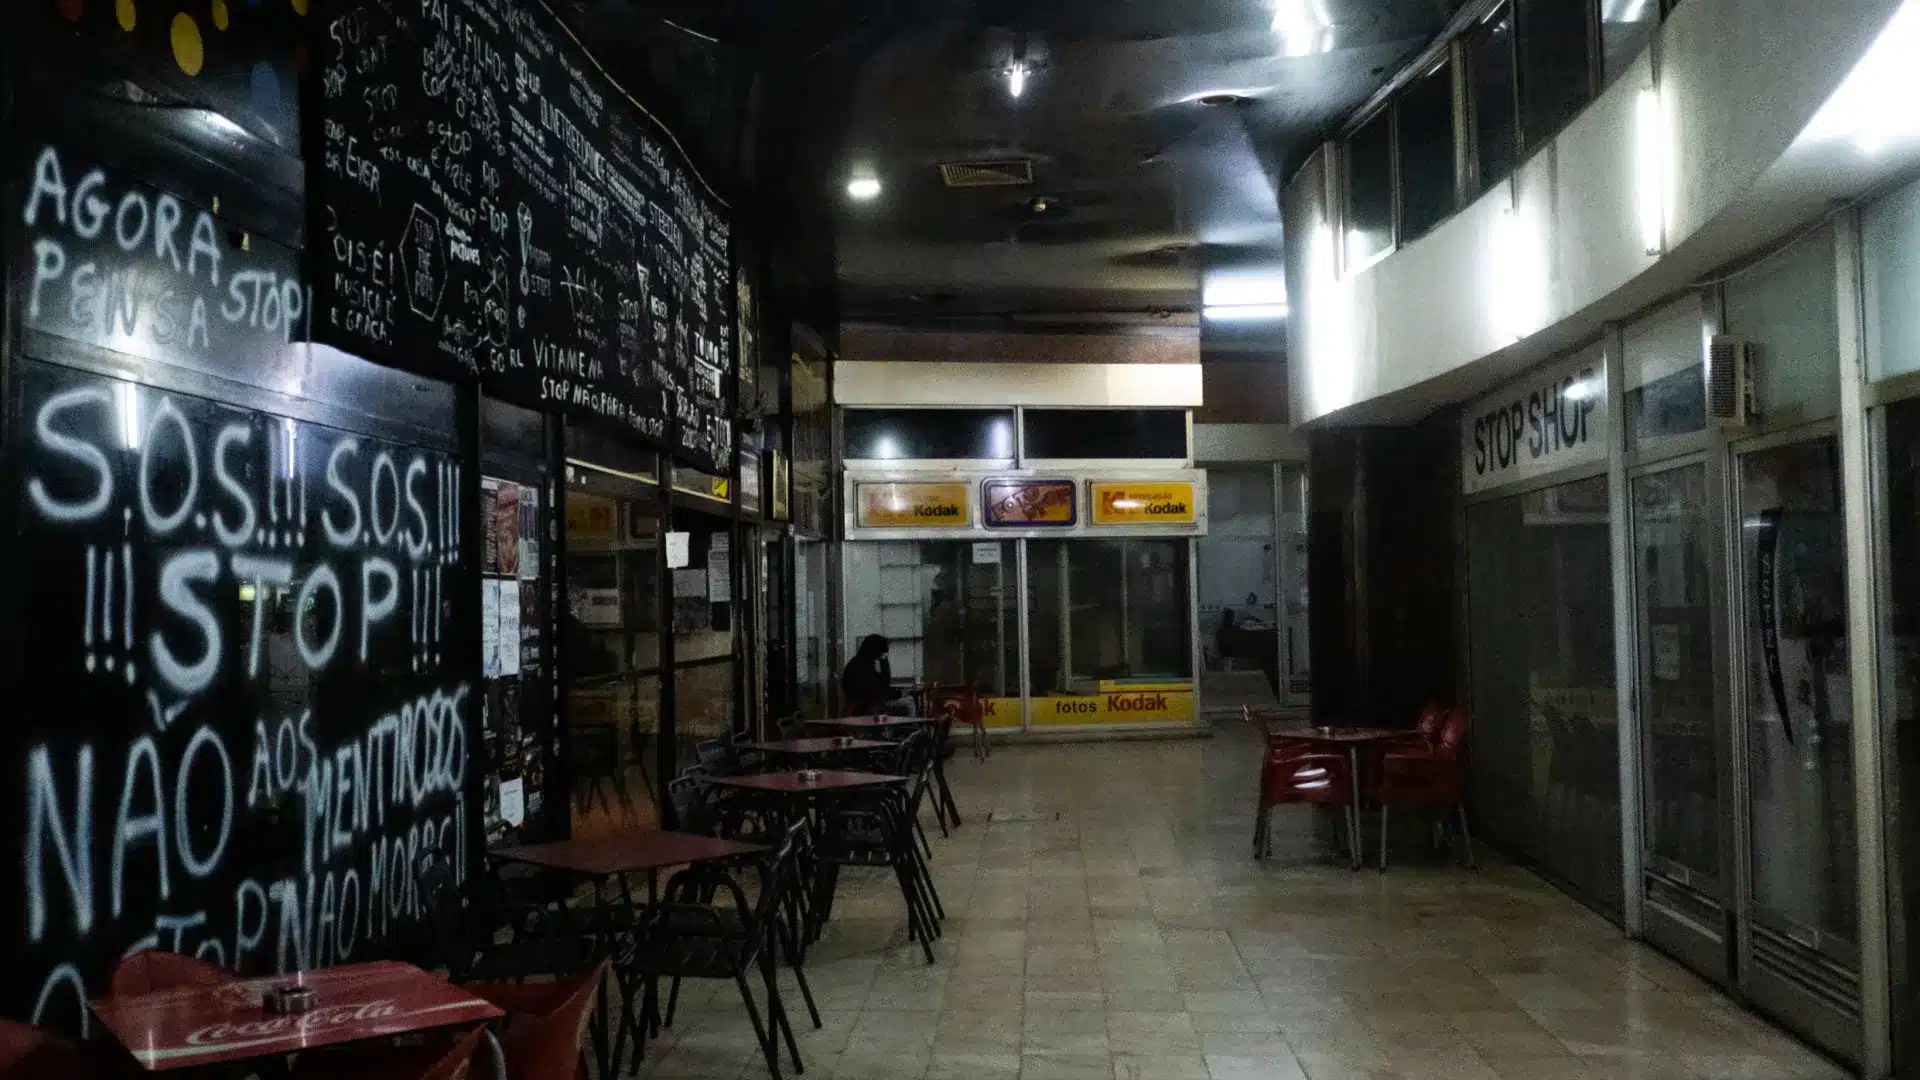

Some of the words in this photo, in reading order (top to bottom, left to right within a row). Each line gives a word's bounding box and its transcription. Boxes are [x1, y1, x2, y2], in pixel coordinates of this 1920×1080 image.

[23, 144, 222, 287] AGORA
[541, 376, 570, 401] STOP
[1474, 400, 1524, 475] STOP
[1529, 367, 1596, 459] SHOP
[914, 503, 961, 517] Kodak
[1145, 501, 1188, 515] Kodak
[149, 547, 399, 693] STOP
[1055, 700, 1097, 714] fotos
[1107, 694, 1169, 713] Kodak
[27, 688, 234, 944] NÃO
[246, 709, 319, 809] AOS
[303, 682, 471, 876] MENTIROSOS
